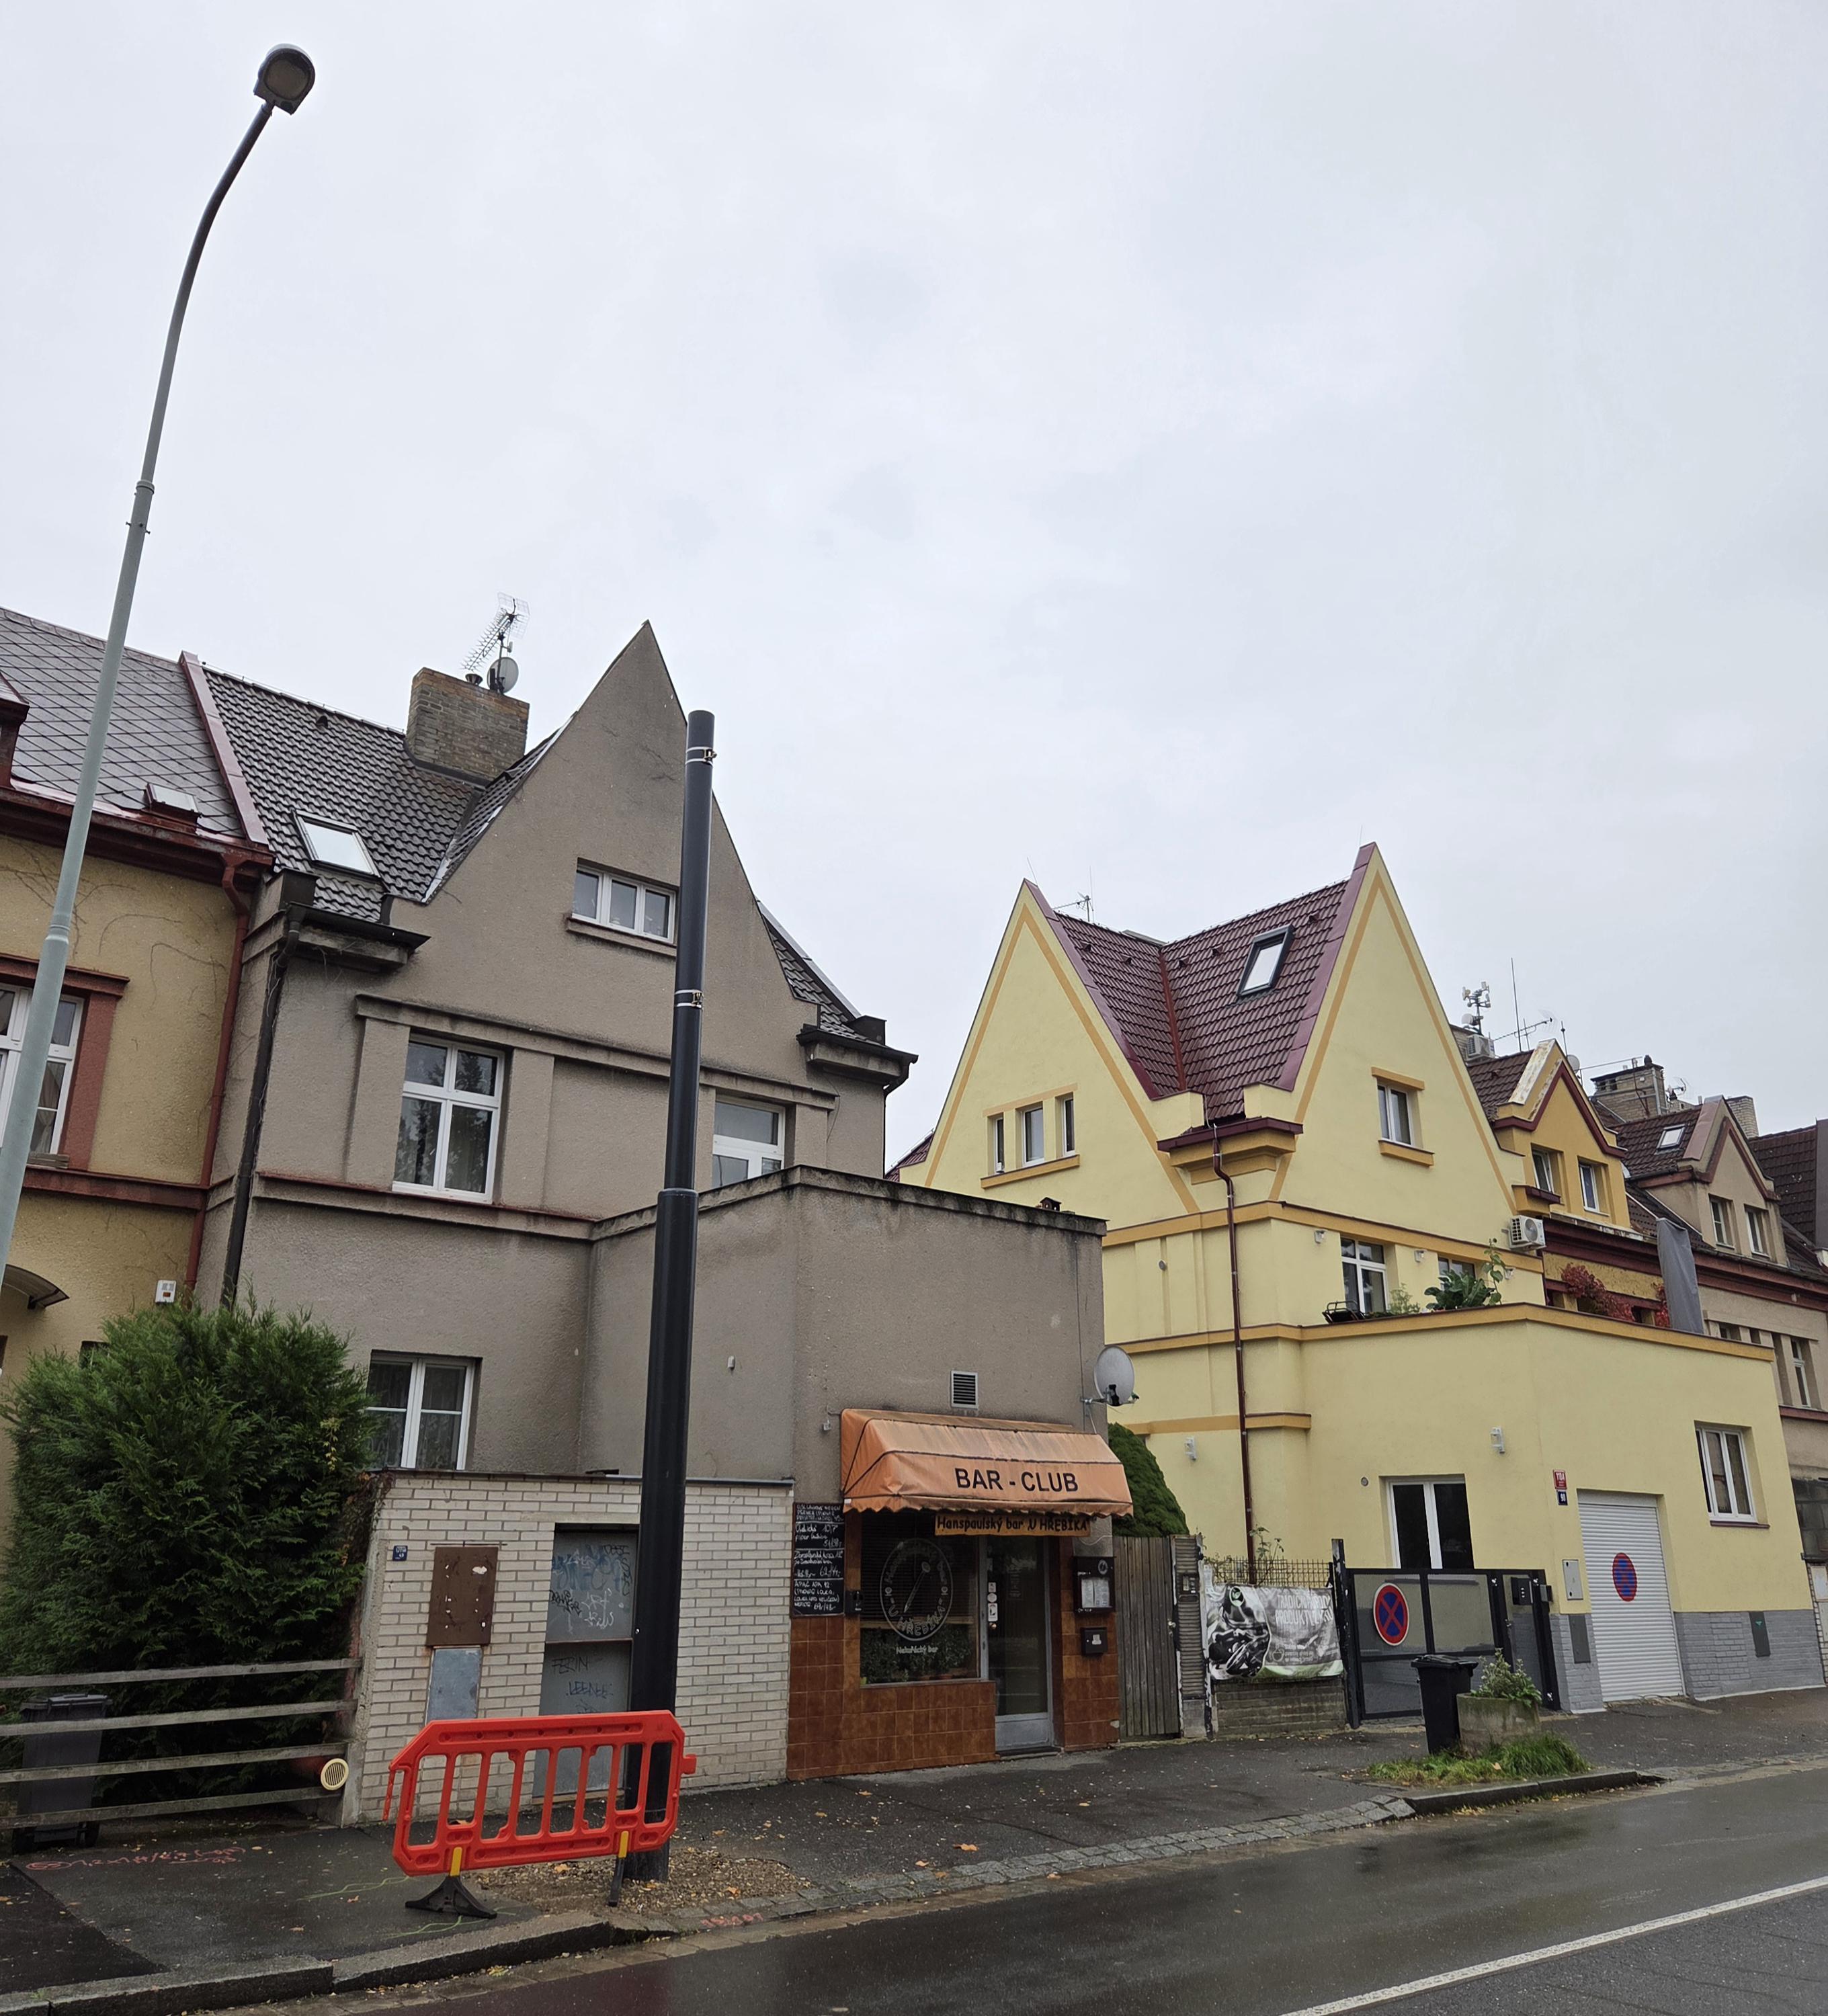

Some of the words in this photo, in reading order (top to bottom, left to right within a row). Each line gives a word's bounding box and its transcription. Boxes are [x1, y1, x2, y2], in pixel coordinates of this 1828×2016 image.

[954, 1468, 1003, 1490] BAR
[1021, 1472, 1078, 1492] CLUB
[937, 1515, 1003, 1532] Hanspaulský
[1006, 1516, 1023, 1529] bar
